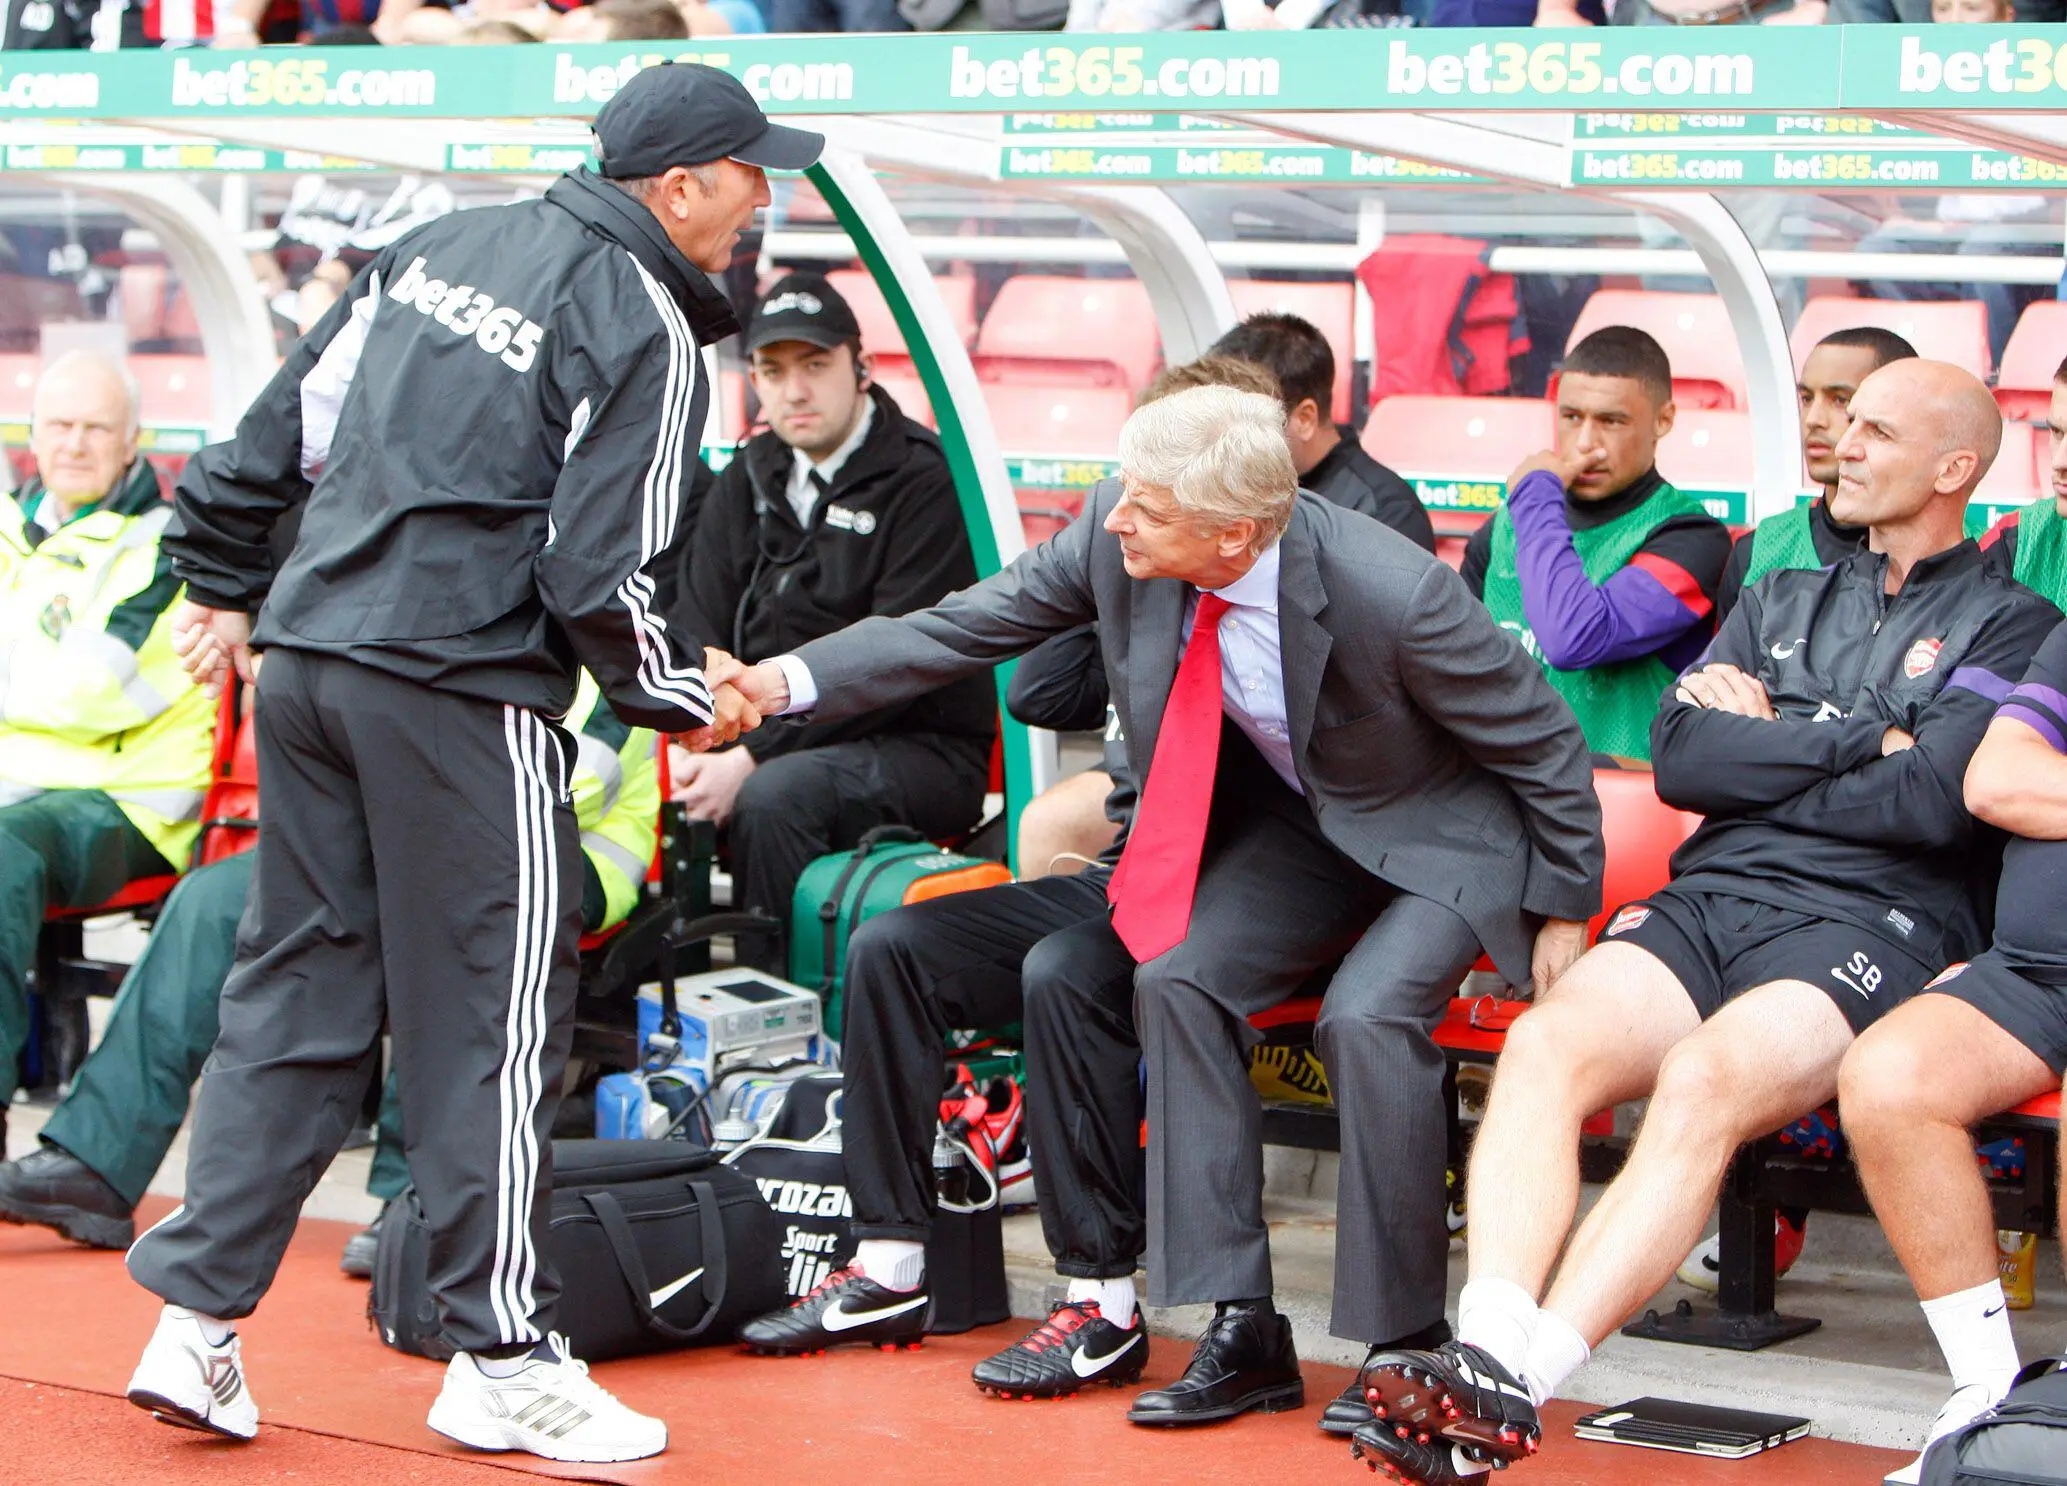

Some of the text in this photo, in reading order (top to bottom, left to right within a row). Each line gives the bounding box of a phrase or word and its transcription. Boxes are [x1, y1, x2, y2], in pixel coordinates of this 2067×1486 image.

[172, 58, 436, 106] bet365.com
[553, 52, 854, 103] betcom
[949, 46, 1281, 98] bet365.com
[1387, 40, 1754, 95] bet365.com
[0, 73, 99, 108] .com
[1583, 152, 1744, 181] bet365.com
[1773, 153, 1940, 181] bet365.com
[387, 255, 545, 373] bet365
[1846, 951, 1882, 993] SB
[781, 1224, 839, 1259] Sport
